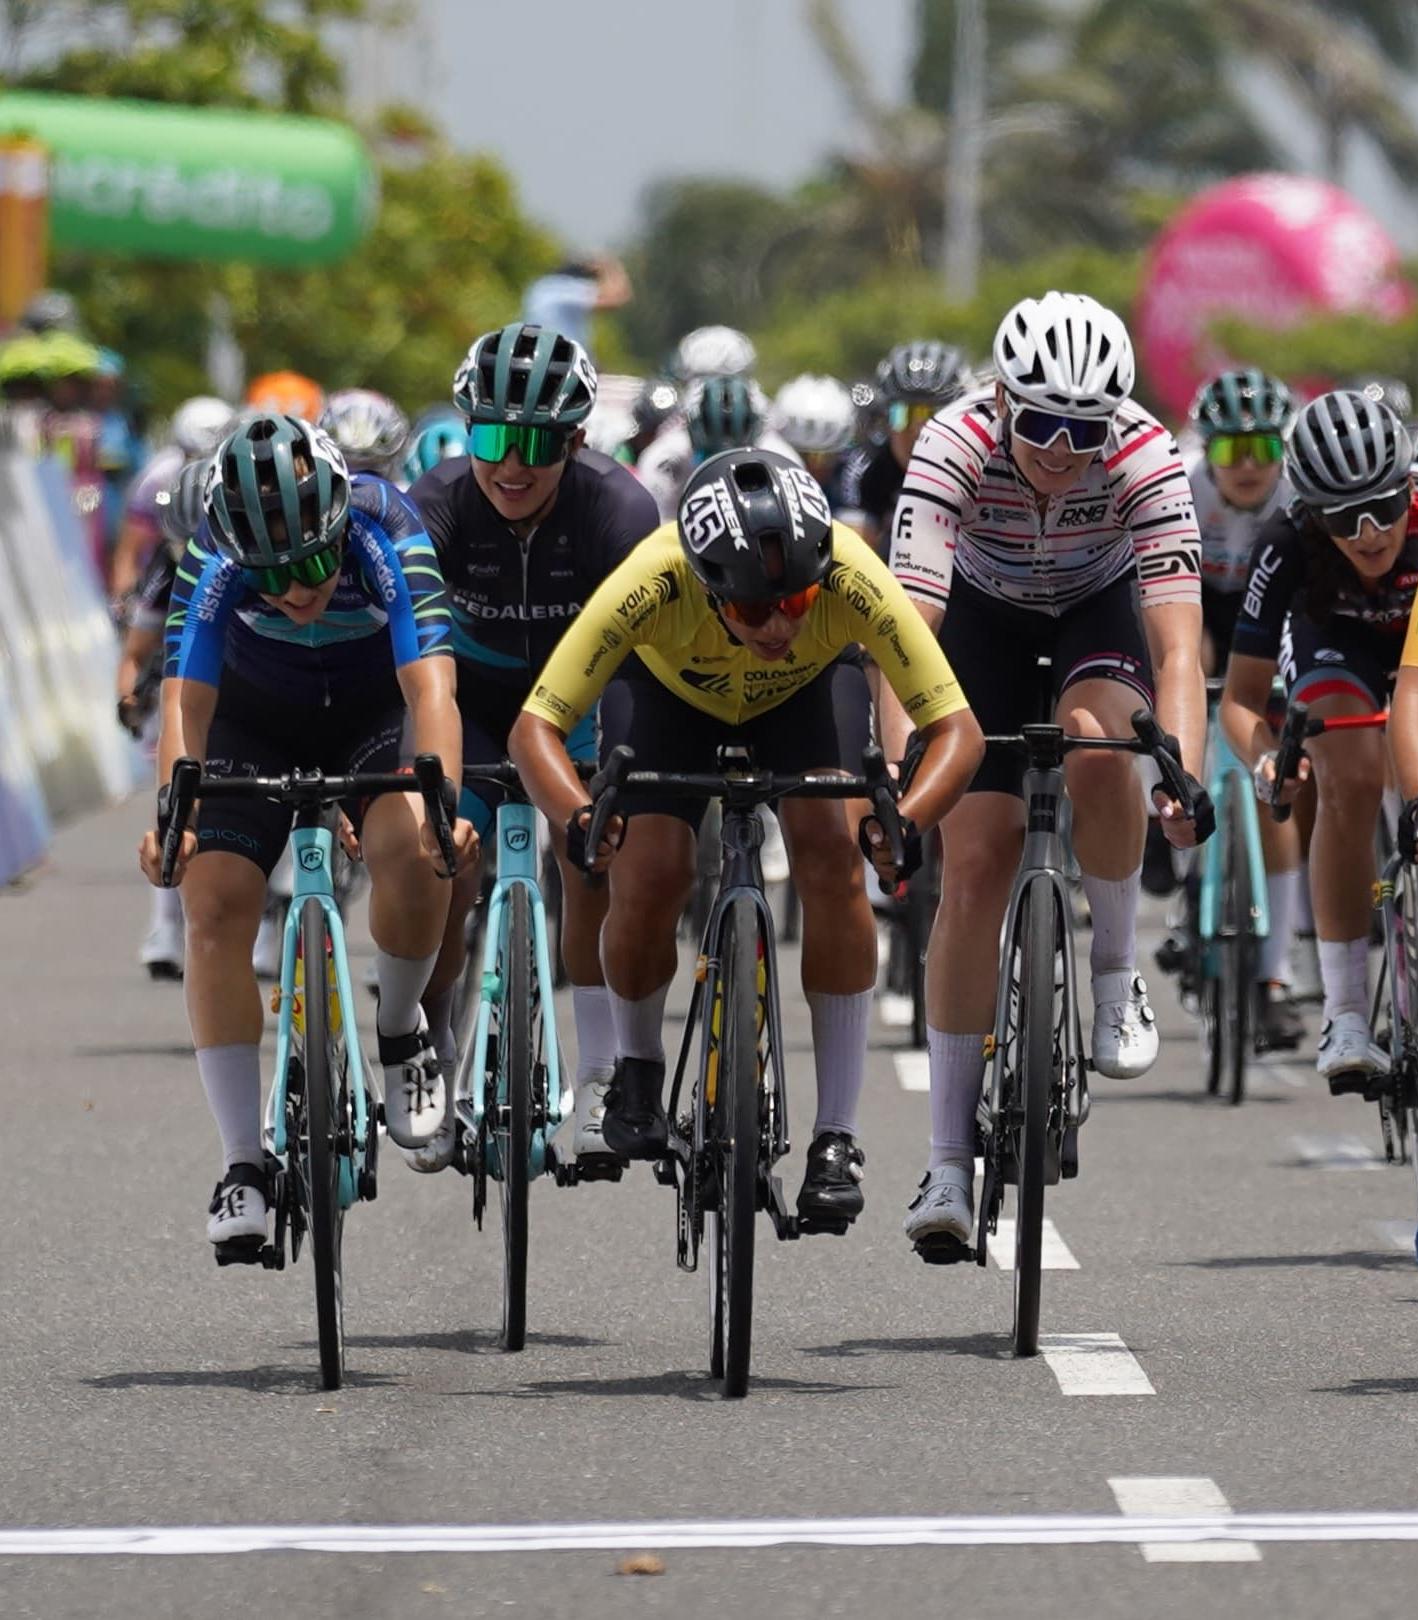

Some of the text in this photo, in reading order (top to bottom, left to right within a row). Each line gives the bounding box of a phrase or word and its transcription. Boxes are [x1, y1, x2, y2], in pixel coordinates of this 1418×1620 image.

[684, 496, 721, 545] 45
[712, 477, 749, 551] TREK
[775, 466, 805, 541] TREK
[1059, 504, 1109, 520] DNA
[456, 588, 488, 603] TEAM
[616, 585, 650, 618] VIDA
[1243, 544, 1283, 619] BMC
[845, 587, 872, 622] VIDA
